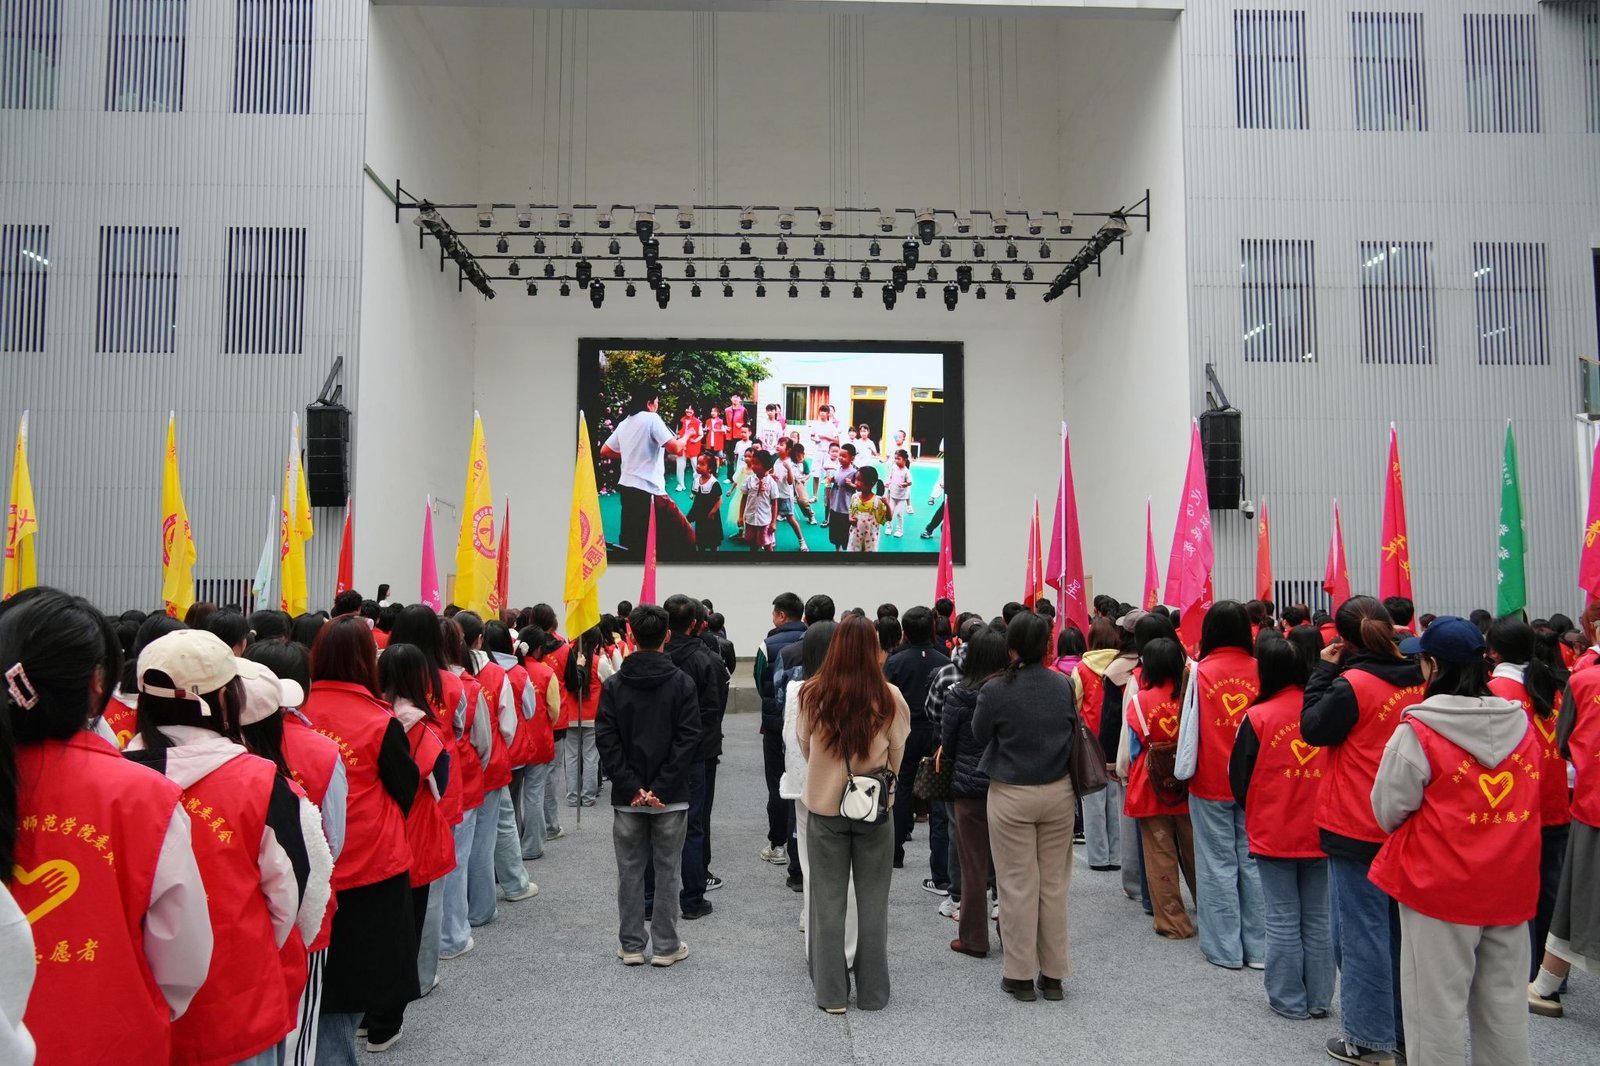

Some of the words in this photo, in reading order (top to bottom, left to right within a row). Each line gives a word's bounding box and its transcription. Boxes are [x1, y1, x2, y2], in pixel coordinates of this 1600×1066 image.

[1466, 809, 1531, 825] 青年志愿者
